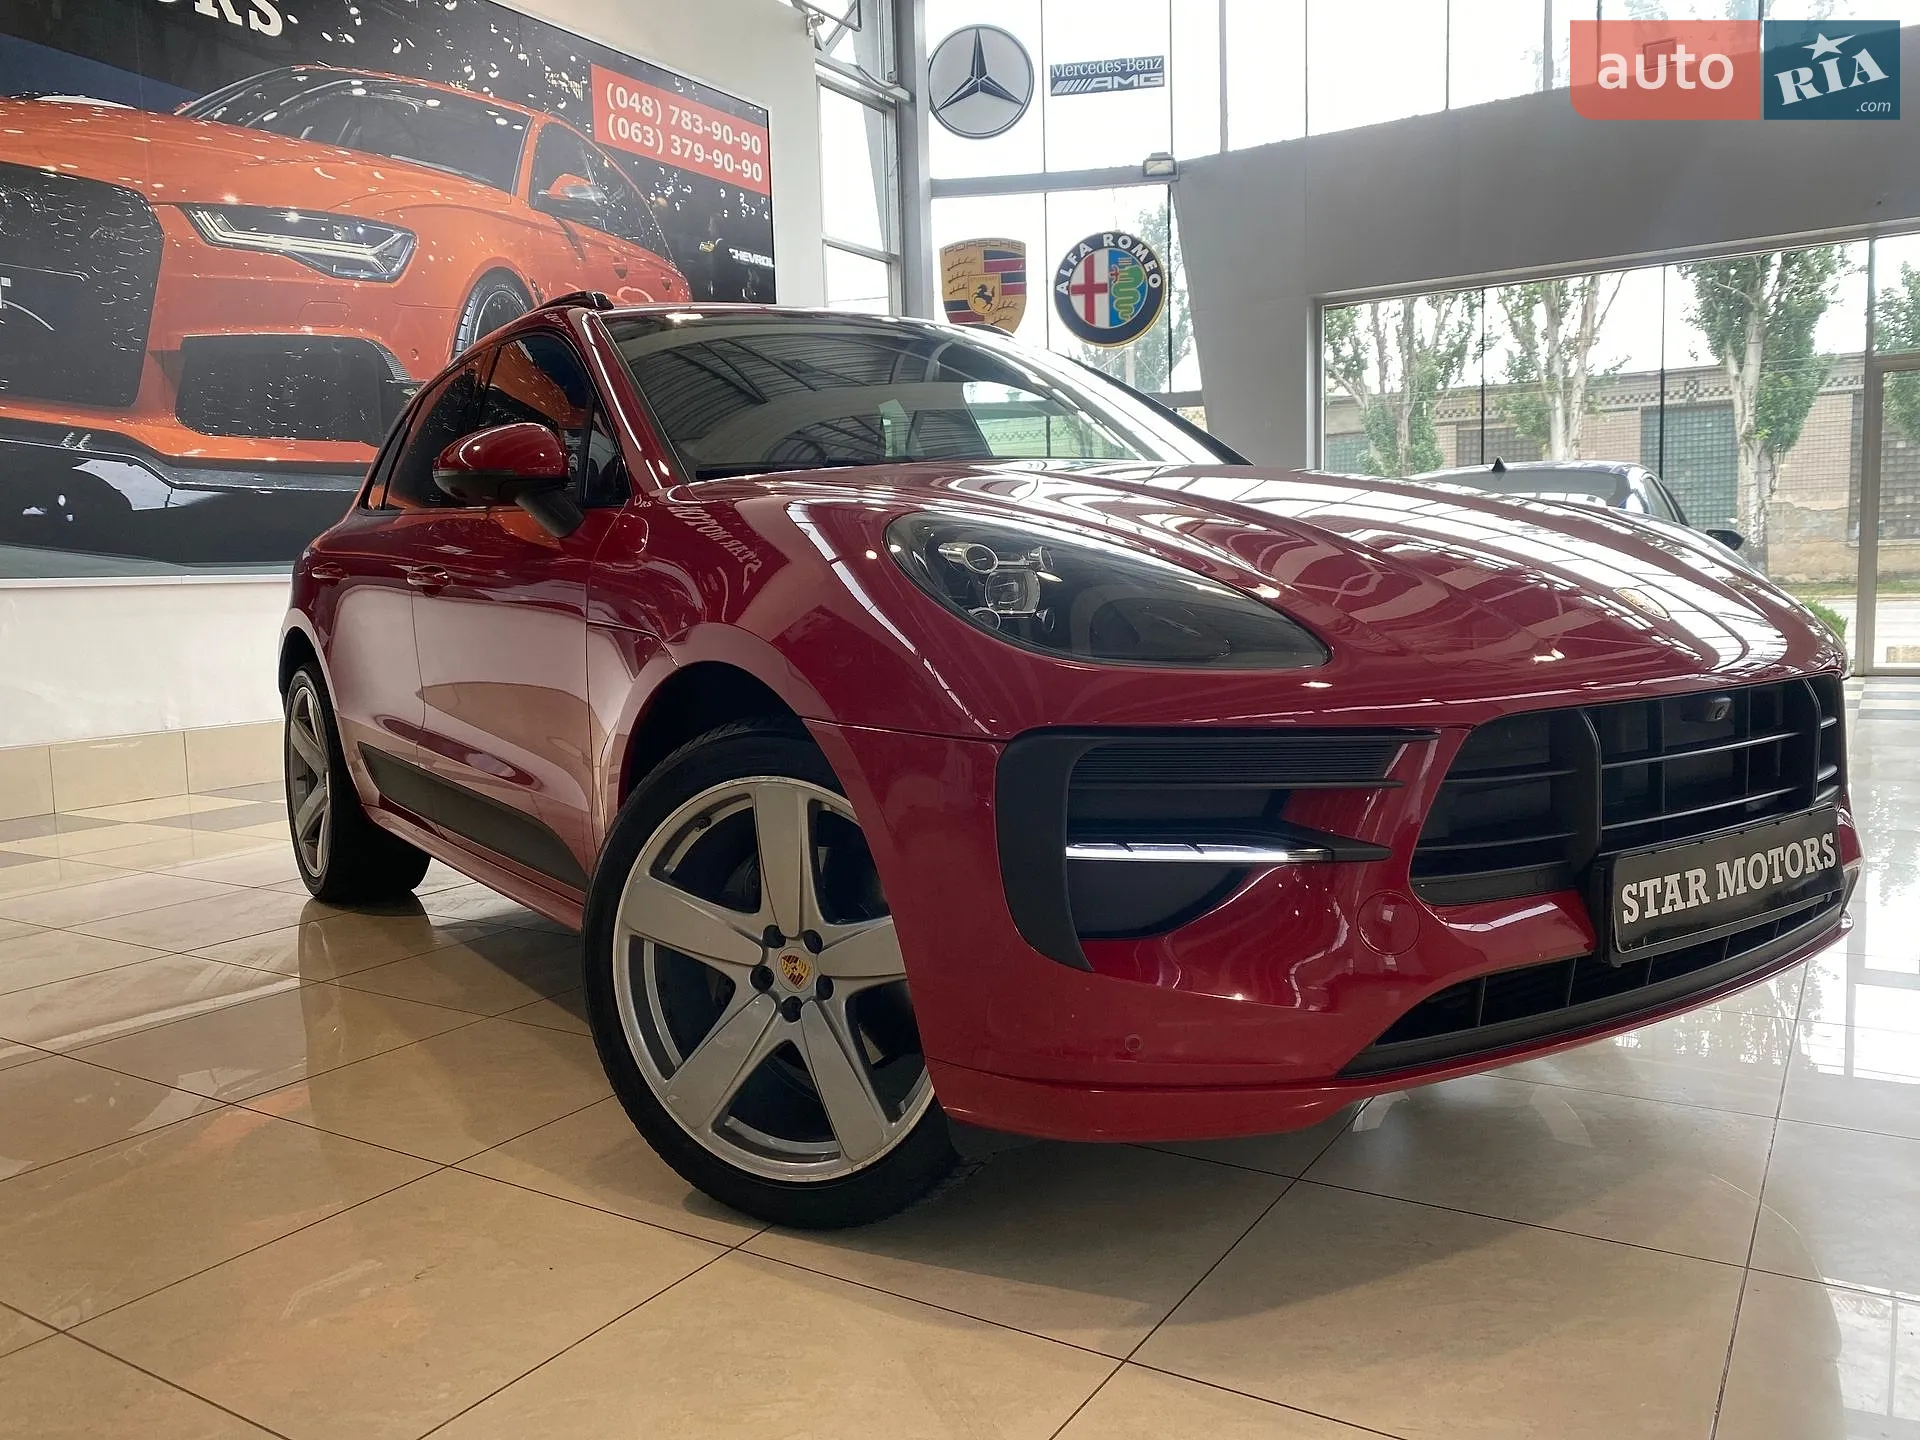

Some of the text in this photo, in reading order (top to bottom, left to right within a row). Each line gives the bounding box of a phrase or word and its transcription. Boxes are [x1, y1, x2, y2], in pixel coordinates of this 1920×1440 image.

[1051, 56, 1162, 78] Mercedes-Benz
[606, 83, 761, 155] (048) 783-90-90
[608, 114, 762, 182] (063) 379-90-90
[944, 239, 1024, 256] PORSCHE
[1056, 233, 1162, 294] ALFA ROMEO
[1621, 832, 1836, 924] STAR MOTORS
